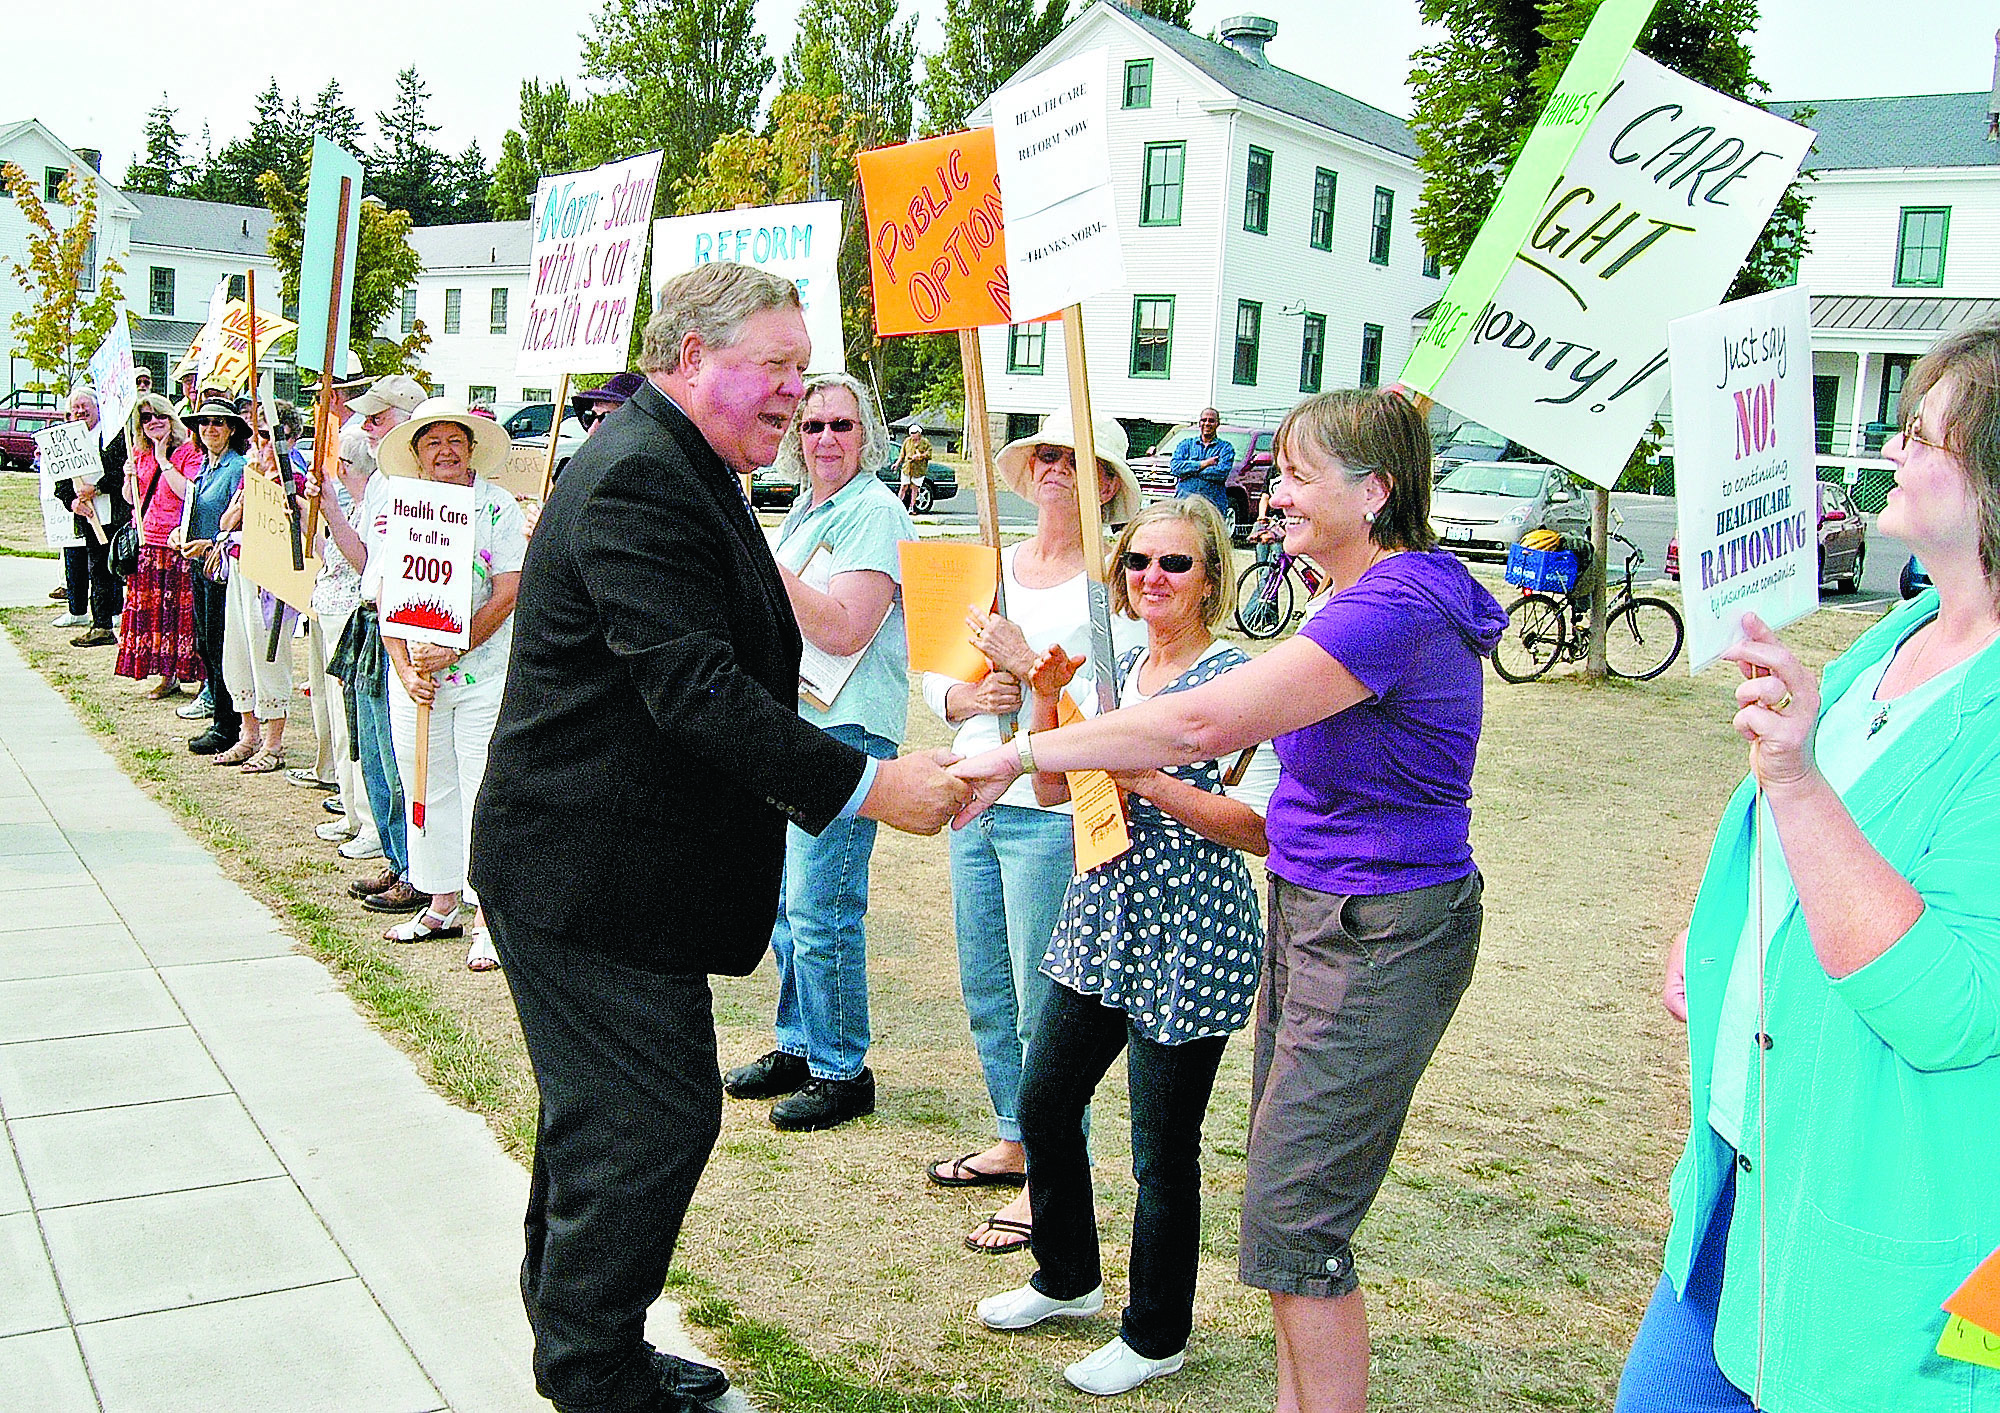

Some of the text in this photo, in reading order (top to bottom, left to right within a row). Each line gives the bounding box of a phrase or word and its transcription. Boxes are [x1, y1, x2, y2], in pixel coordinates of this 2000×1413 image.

[1015, 82, 1088, 126] HEALTH CARE
[1541, 91, 1599, 127] ANIES
[1018, 118, 1089, 161] REFORM NOW
[1609, 103, 1784, 207] CARE
[604, 160, 660, 231] stand
[694, 223, 813, 266] REFORM
[535, 238, 631, 296] with us on
[522, 292, 581, 351] health
[585, 296, 627, 345] care
[223, 334, 248, 354] THE
[1716, 324, 1788, 390] Just say
[50, 428, 69, 445] FOR
[1733, 378, 1776, 461] NO!
[44, 437, 83, 461] PUBLIC
[250, 477, 282, 509] THA
[1722, 459, 1788, 498] to continuing
[257, 511, 287, 542] NOR
[394, 498, 468, 526] Health Care
[1715, 484, 1792, 537] HEALTHCARE
[408, 527, 450, 547] for all in
[1700, 508, 1807, 592] RATIONING
[402, 554, 453, 586] 2009
[1720, 577, 1760, 607] insurance
[1760, 562, 1797, 592] companies
